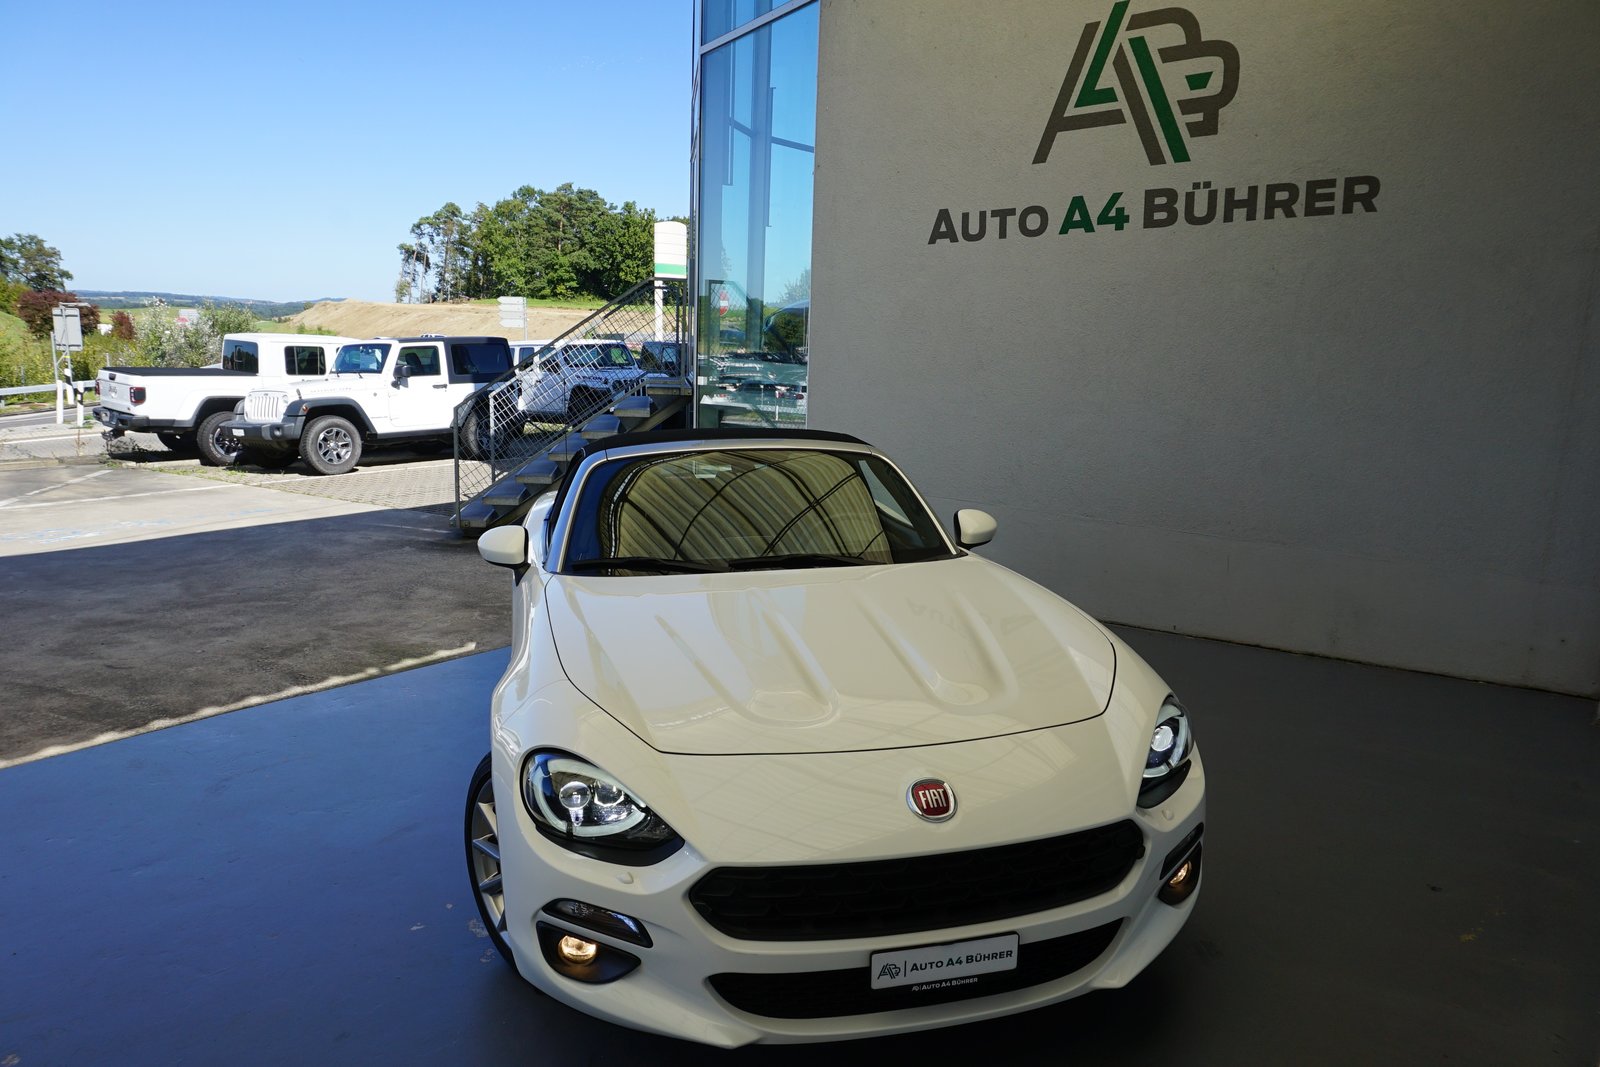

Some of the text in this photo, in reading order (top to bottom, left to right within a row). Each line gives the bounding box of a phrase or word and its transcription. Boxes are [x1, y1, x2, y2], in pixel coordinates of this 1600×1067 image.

[928, 175, 1381, 245] AUTO A4 BÜHRER
[918, 788, 947, 810] FIAT
[910, 960, 944, 972] AUTO
[946, 956, 963, 967] A4
[965, 950, 1013, 964] BÜHRER
[951, 977, 978, 986] BÜHRER
